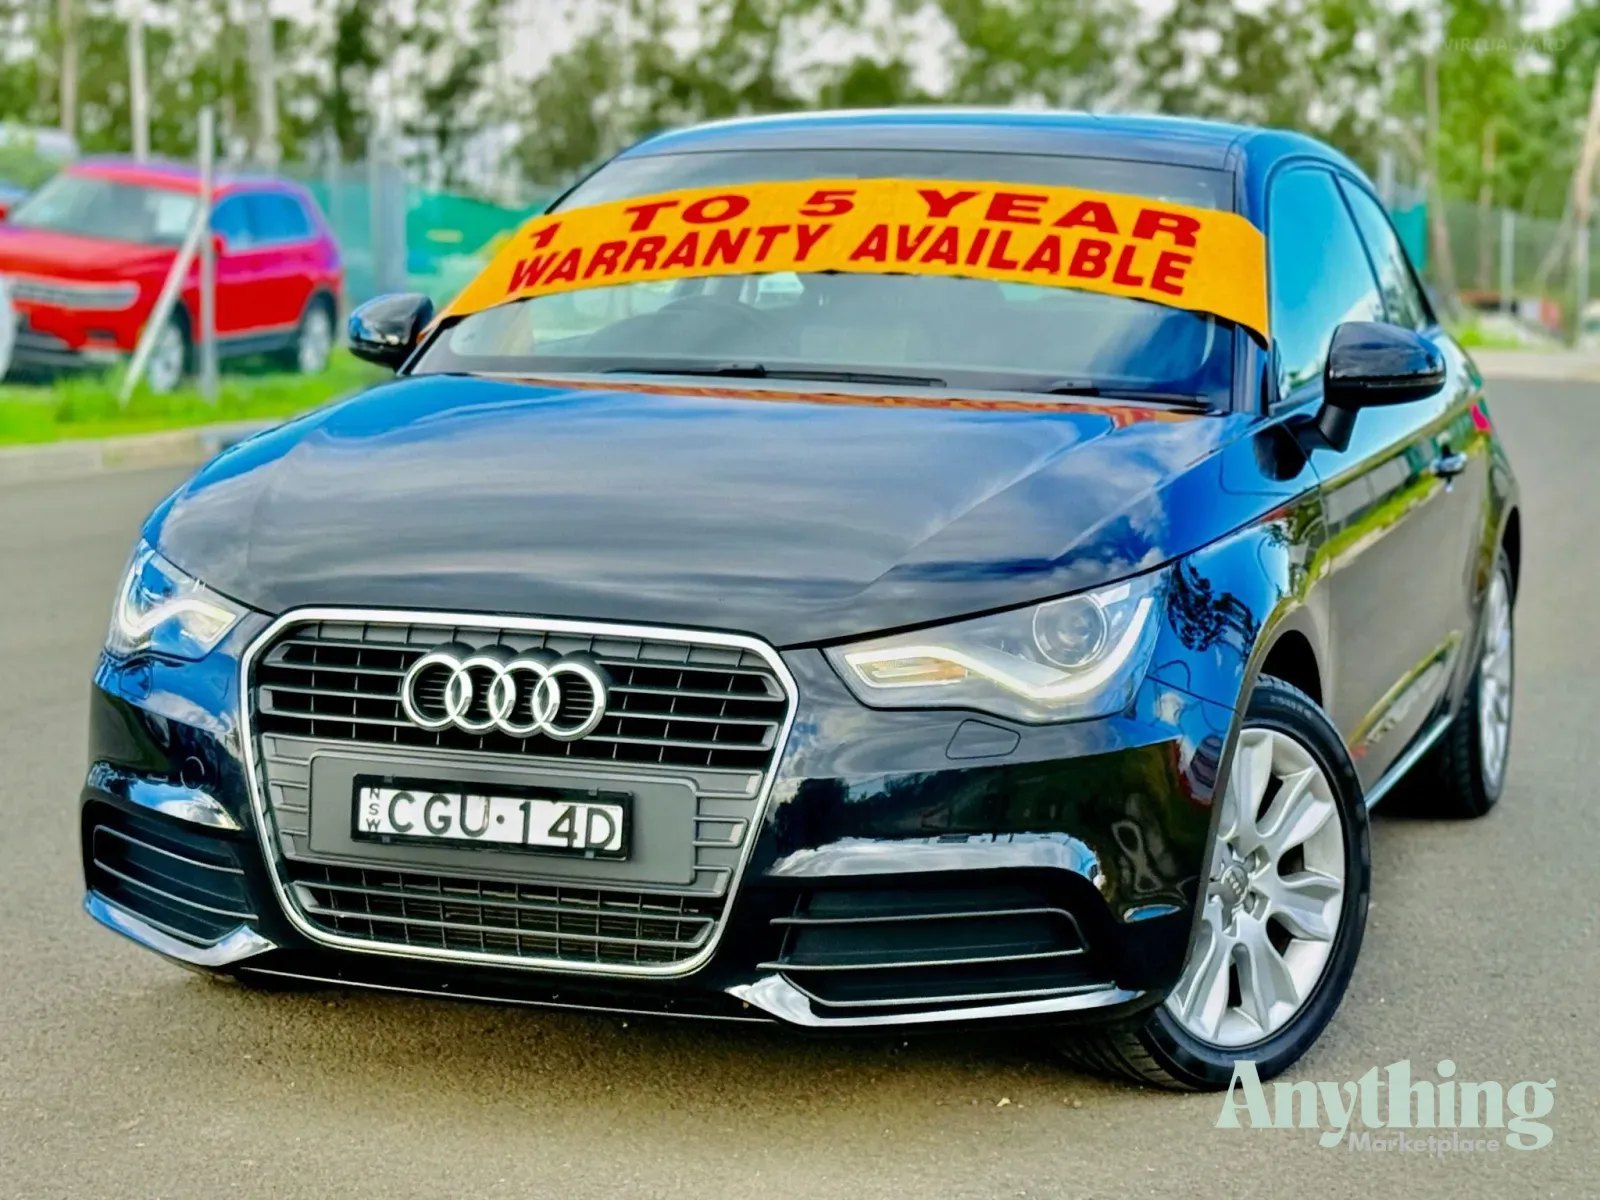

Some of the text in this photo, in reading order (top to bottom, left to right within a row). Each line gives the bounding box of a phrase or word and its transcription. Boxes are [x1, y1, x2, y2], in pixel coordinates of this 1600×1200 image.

[530, 189, 1201, 248] 1 TO 5 YEAR
[507, 223, 1193, 296] WARRANTY AVAILABLE
